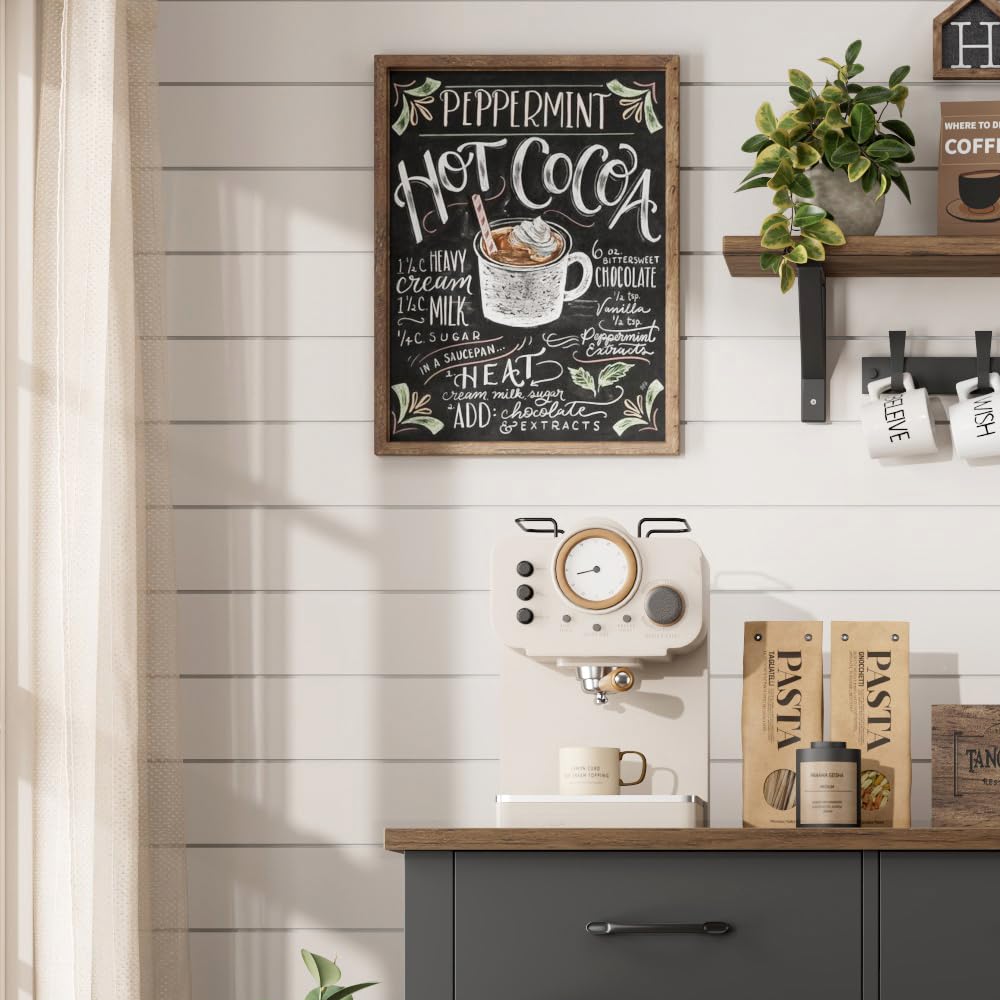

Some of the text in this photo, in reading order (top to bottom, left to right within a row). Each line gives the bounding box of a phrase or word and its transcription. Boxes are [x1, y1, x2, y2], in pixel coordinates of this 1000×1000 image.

[950, 21, 1000, 69] H
[439, 89, 612, 129] PEPPERMINT
[944, 121, 976, 131] WHERE
[978, 121, 991, 129] TO
[394, 137, 662, 244] HOT COCOA
[592, 240, 603, 259] 6
[603, 255, 660, 264] BITTERSWEET
[430, 248, 467, 273] HEAVY
[396, 275, 473, 295] cream
[595, 266, 656, 288] CHOCOLATE
[430, 295, 469, 326] MILK
[596, 297, 651, 316] Vanilla
[429, 330, 480, 343] SUGAR
[581, 320, 660, 346] Peppermint
[586, 343, 654, 357] Extracts
[419, 363, 431, 375] IN
[434, 358, 440, 368] A
[454, 347, 546, 390] HEAT
[528, 389, 565, 407] sugar
[501, 401, 608, 419] chocolate
[974, 397, 996, 438] WISH
[499, 420, 601, 434] & EXTRACTS
[777, 650, 802, 752] PASTA
[867, 650, 892, 752] PASTA
